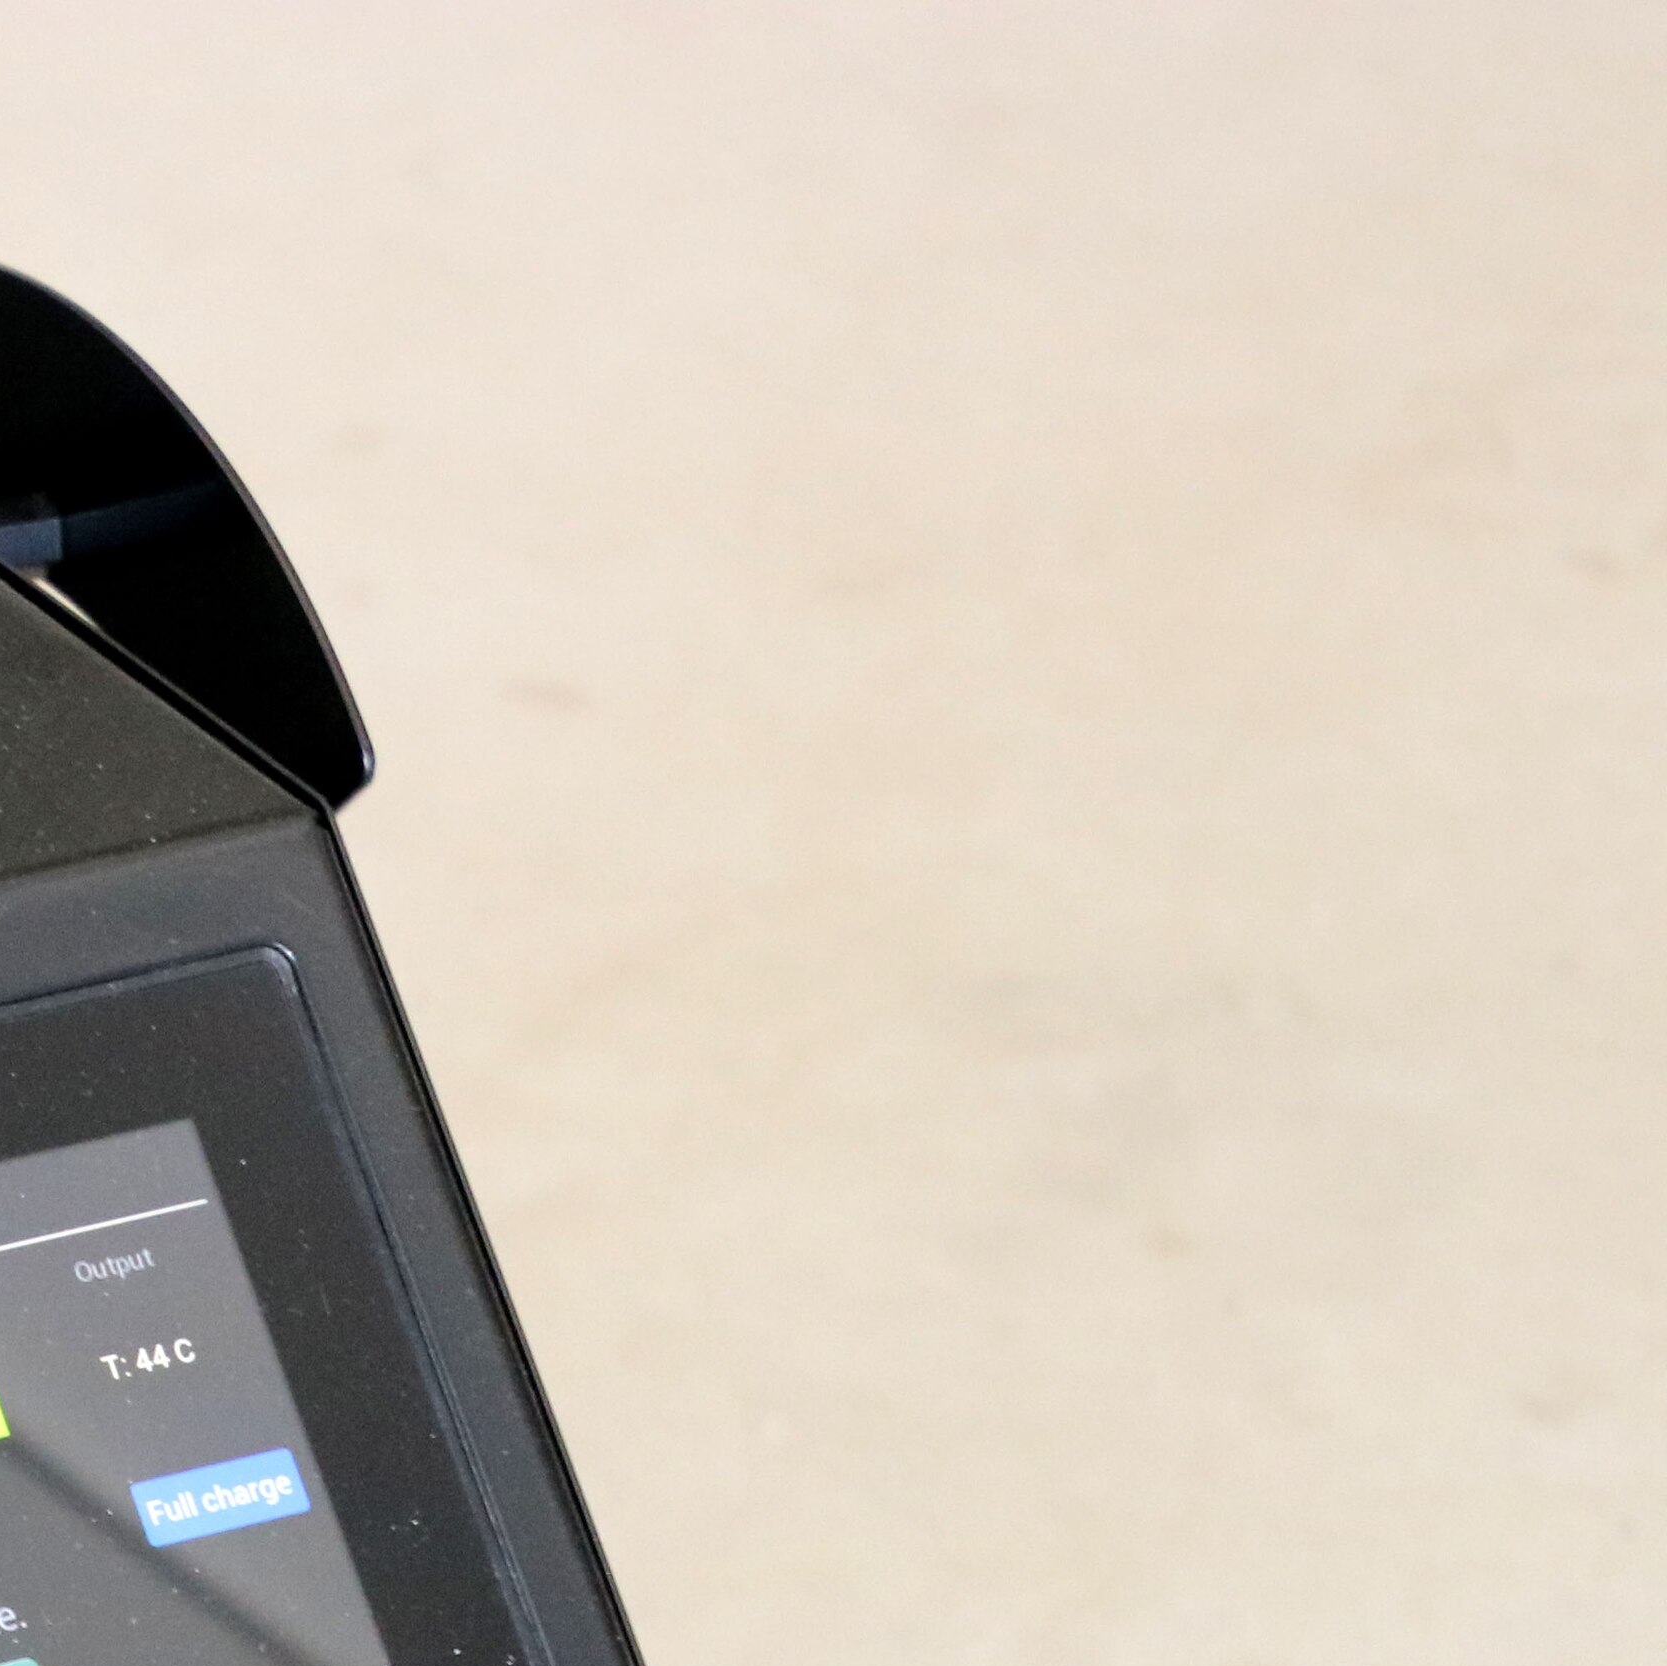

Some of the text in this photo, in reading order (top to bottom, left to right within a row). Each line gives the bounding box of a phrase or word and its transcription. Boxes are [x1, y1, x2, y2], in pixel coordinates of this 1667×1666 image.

[73, 1248, 156, 1283] Output
[99, 1337, 197, 1380] T: 44 C
[145, 1474, 294, 1527] Full charge
